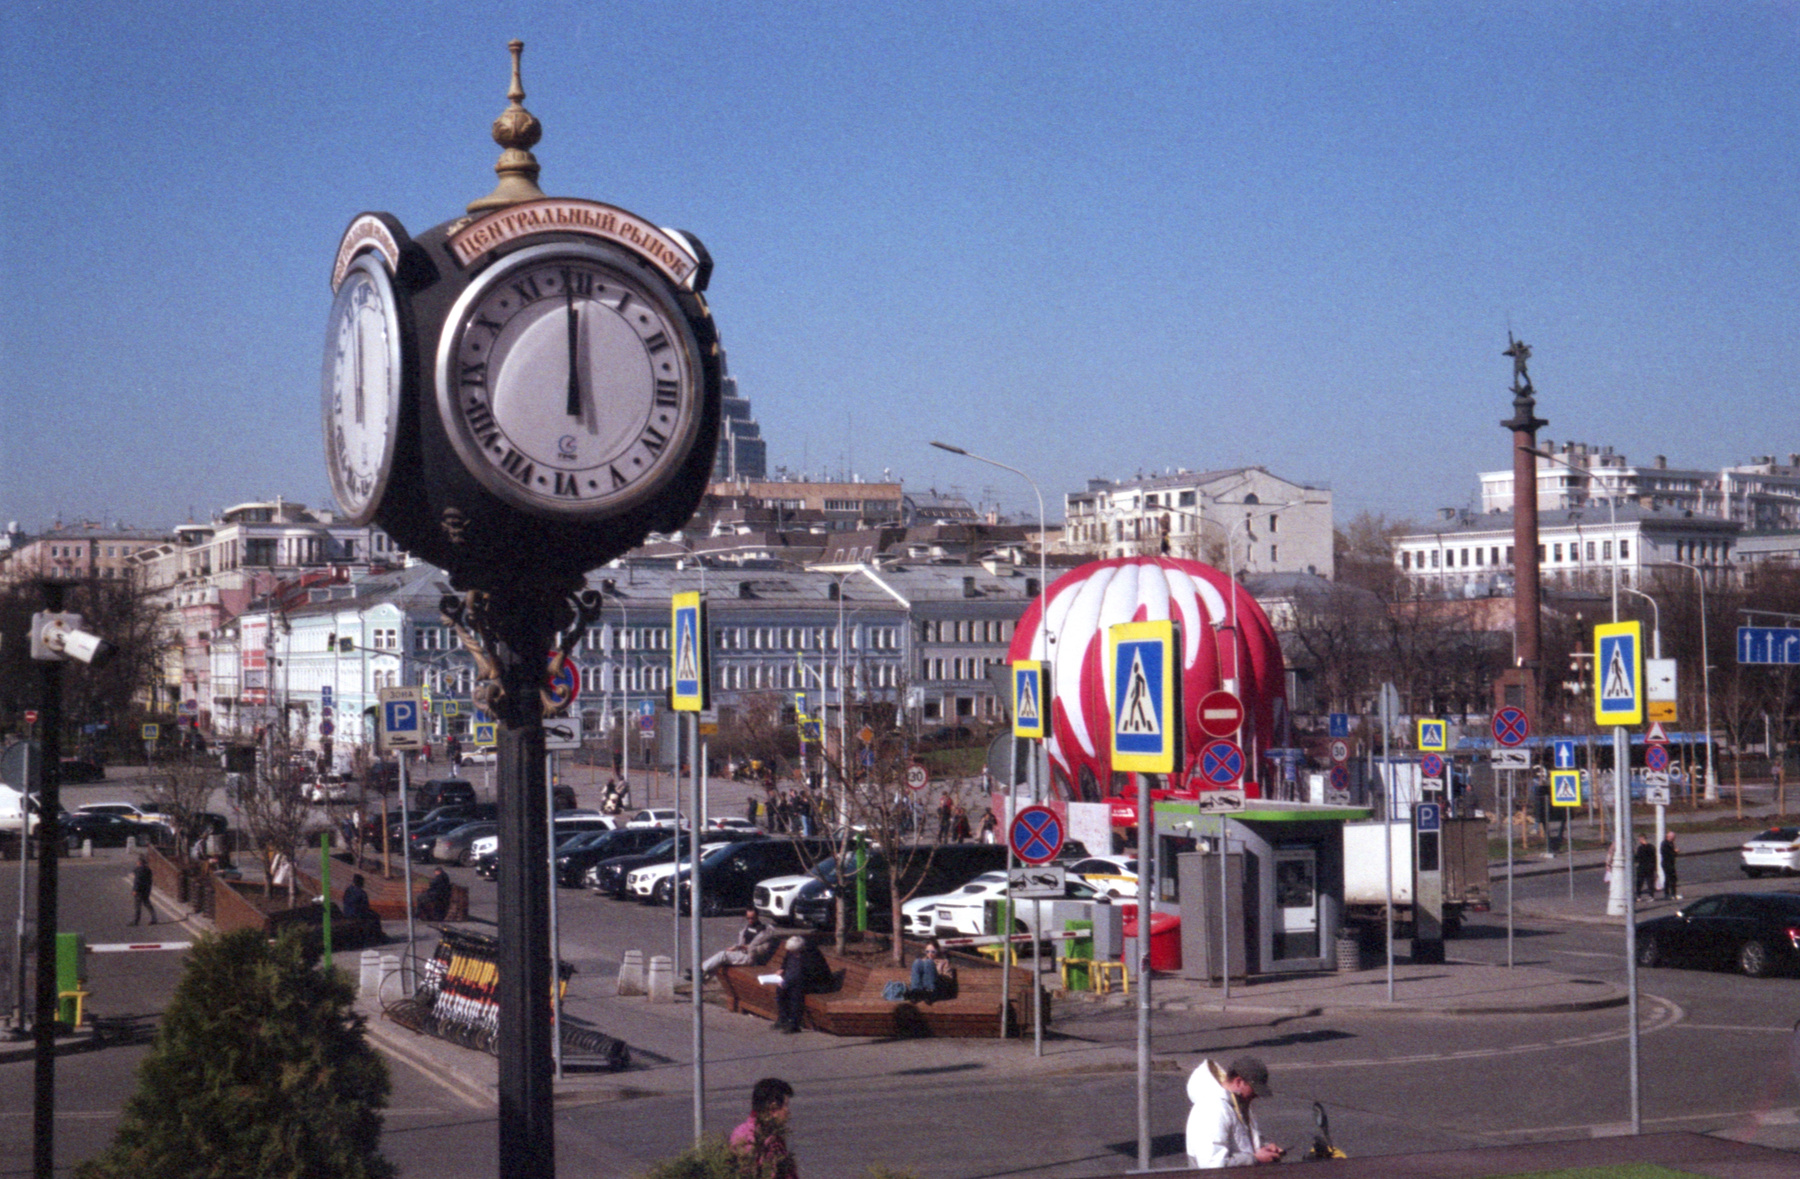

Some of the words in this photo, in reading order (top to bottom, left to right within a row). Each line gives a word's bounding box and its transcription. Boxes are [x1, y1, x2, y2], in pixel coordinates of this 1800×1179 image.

[459, 208, 616, 256] ЦЕНТРАЛЬНЫЙ
[618, 222, 690, 276] РЫНОК
[511, 276, 542, 302] XI
[476, 313, 502, 337] X
[645, 331, 670, 355] II
[656, 378, 679, 407] III
[609, 464, 627, 488] V
[390, 691, 414, 699] ЗОНА
[393, 704, 412, 729] P
[1334, 746, 1346, 757] 30
[908, 771, 923, 782] 30
[1421, 807, 1434, 827] P
